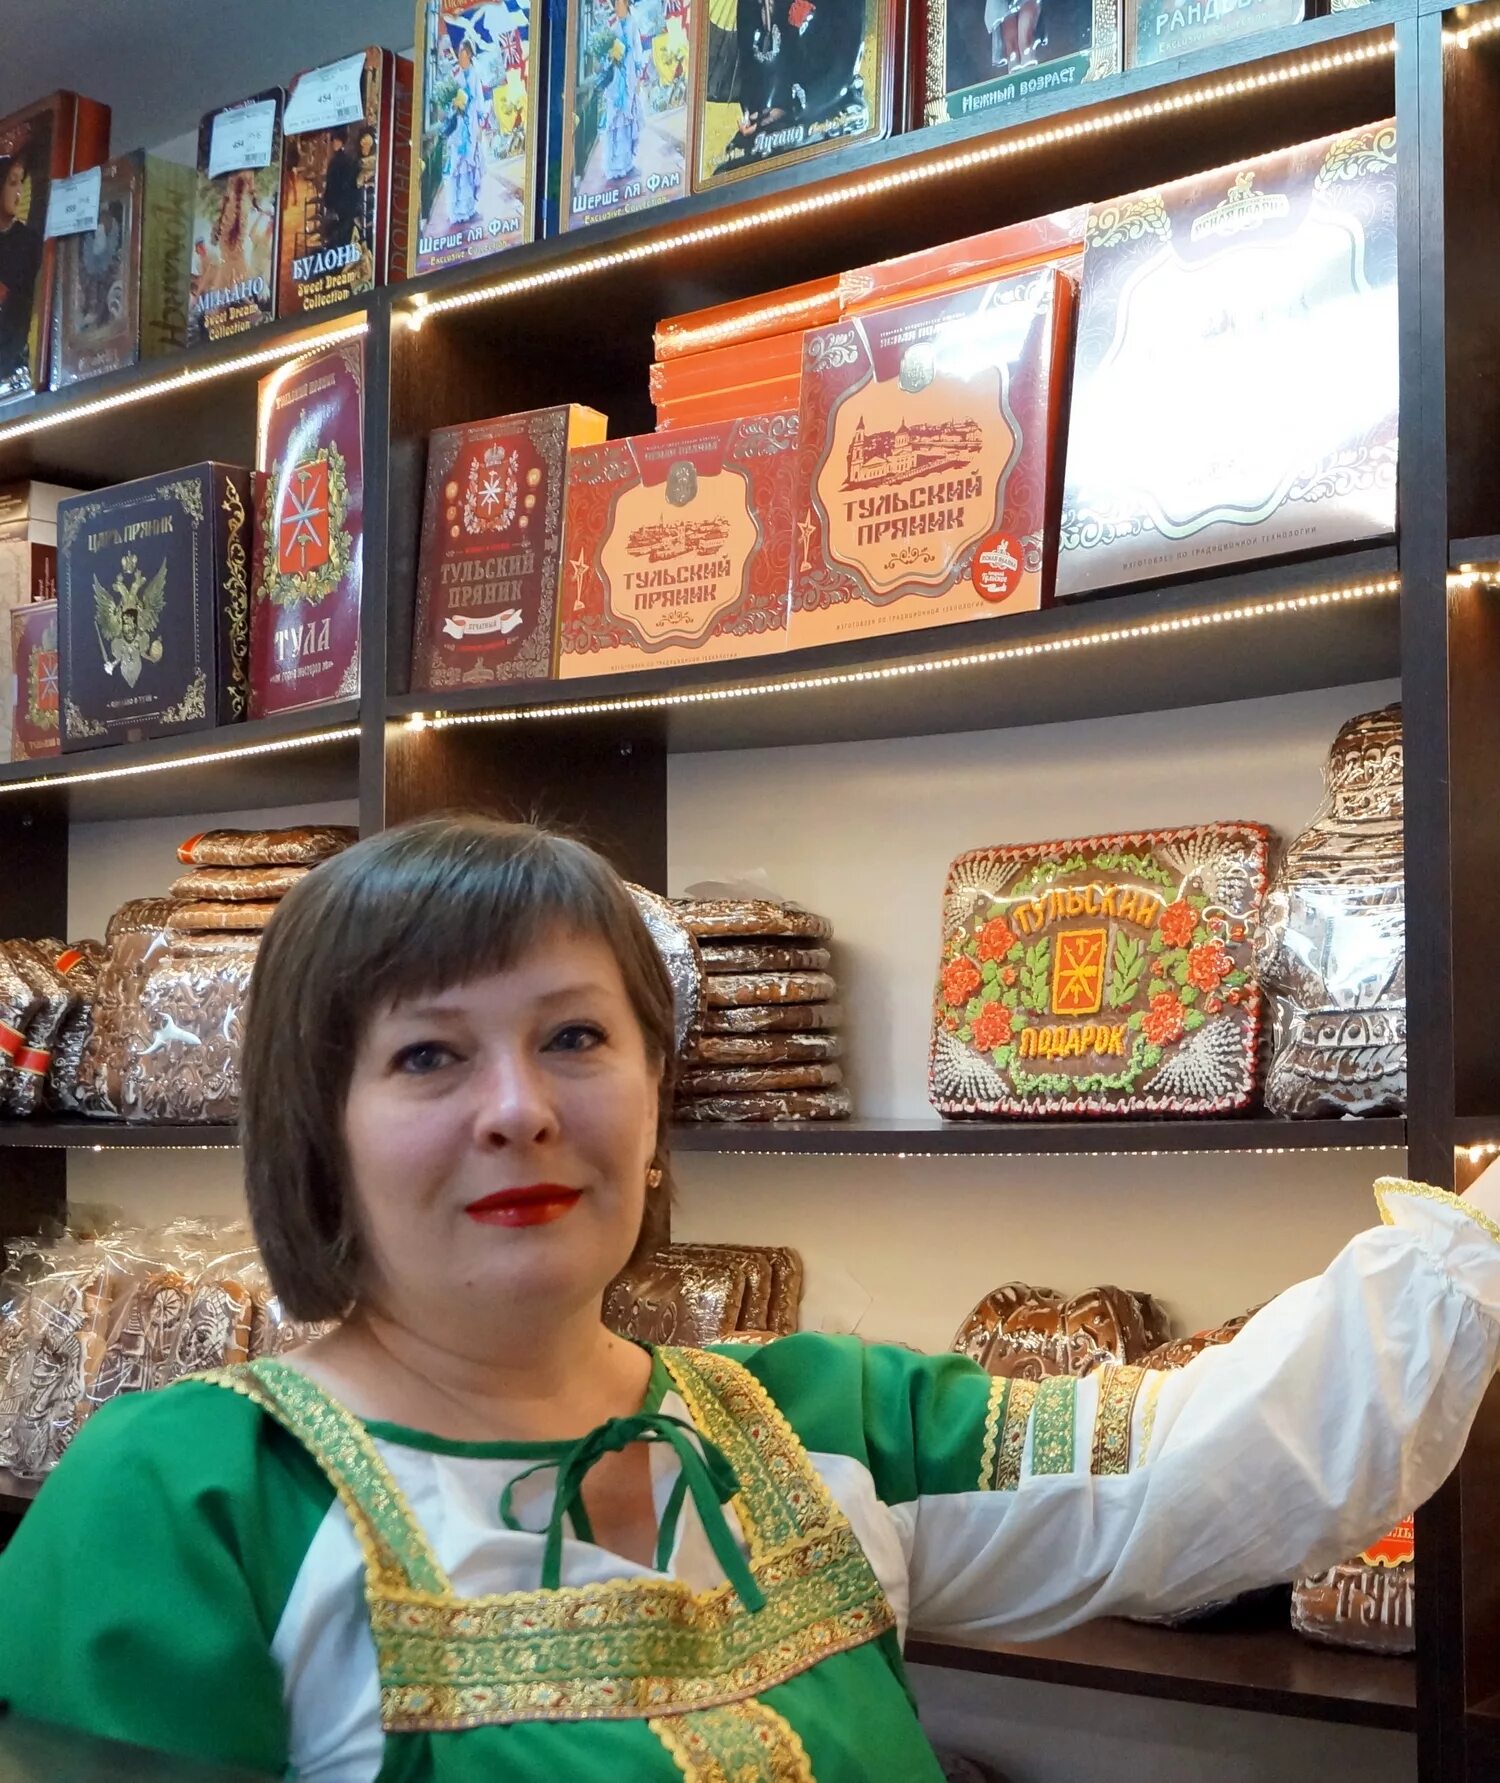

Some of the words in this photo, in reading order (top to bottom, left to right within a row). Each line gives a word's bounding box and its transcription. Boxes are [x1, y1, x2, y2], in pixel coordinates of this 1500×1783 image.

[292, 242, 362, 282] БУЛОНЬ
[303, 289, 350, 312] Collection
[208, 320, 252, 341] Collection
[843, 468, 983, 523] ТУЛЬСКИЙ
[857, 506, 965, 547] ПРЯНИК
[440, 550, 536, 585] ТУЛЬСКИЙ
[623, 554, 732, 591] ТУЛЬСКИЙ
[448, 579, 524, 609] ПРЯНИК
[634, 583, 718, 612] ПРЯНИК
[274, 617, 332, 663] ТУЛА
[1019, 1023, 1127, 1060] ПОДАРОК
